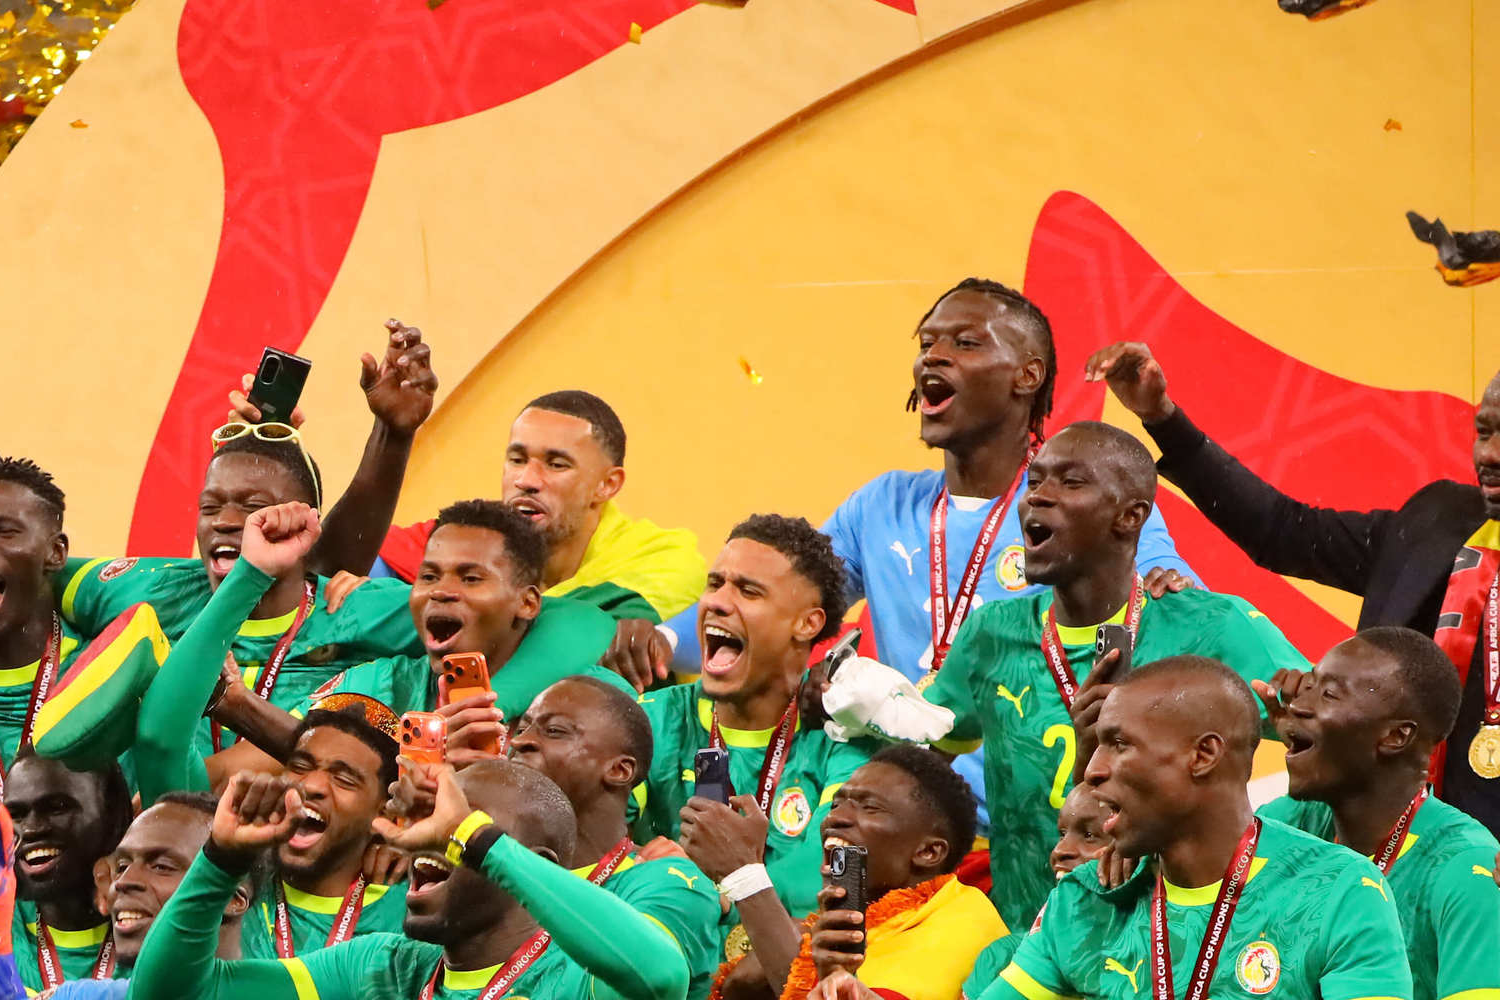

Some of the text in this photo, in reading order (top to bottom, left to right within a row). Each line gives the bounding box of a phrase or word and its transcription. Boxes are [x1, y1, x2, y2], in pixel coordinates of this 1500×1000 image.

[933, 533, 942, 546] OF
[934, 547, 943, 564] CUP
[963, 563, 981, 595] AFRICA
[975, 545, 986, 563] CUP
[981, 531, 991, 545] OF
[934, 565, 943, 594] AFRICA
[1490, 586, 1499, 599] OF
[1489, 599, 1499, 617] CUP
[1490, 617, 1499, 649] AFRICA
[1048, 644, 1069, 683] NATIONS
[39, 662, 54, 701] NATIONS
[266, 675, 275, 688] OF
[1063, 683, 1075, 695] OF
[34, 699, 45, 713] OF
[767, 737, 786, 779] NATIONS
[764, 777, 773, 791] OF
[760, 791, 770, 810] CUP
[1380, 815, 1408, 863] MOROCCO
[1223, 855, 1250, 904] MOROCCO
[335, 905, 355, 943] NATIONS
[1153, 898, 1162, 940] NATIONS
[1210, 902, 1229, 947] NATIONS
[97, 941, 113, 980] NATIONS
[505, 943, 542, 982] MOROCCO
[1155, 940, 1165, 956] OF
[1205, 944, 1216, 960] OF
[41, 948, 57, 982] NATIONS
[1156, 957, 1167, 977] CUP
[1197, 960, 1211, 982] CUP
